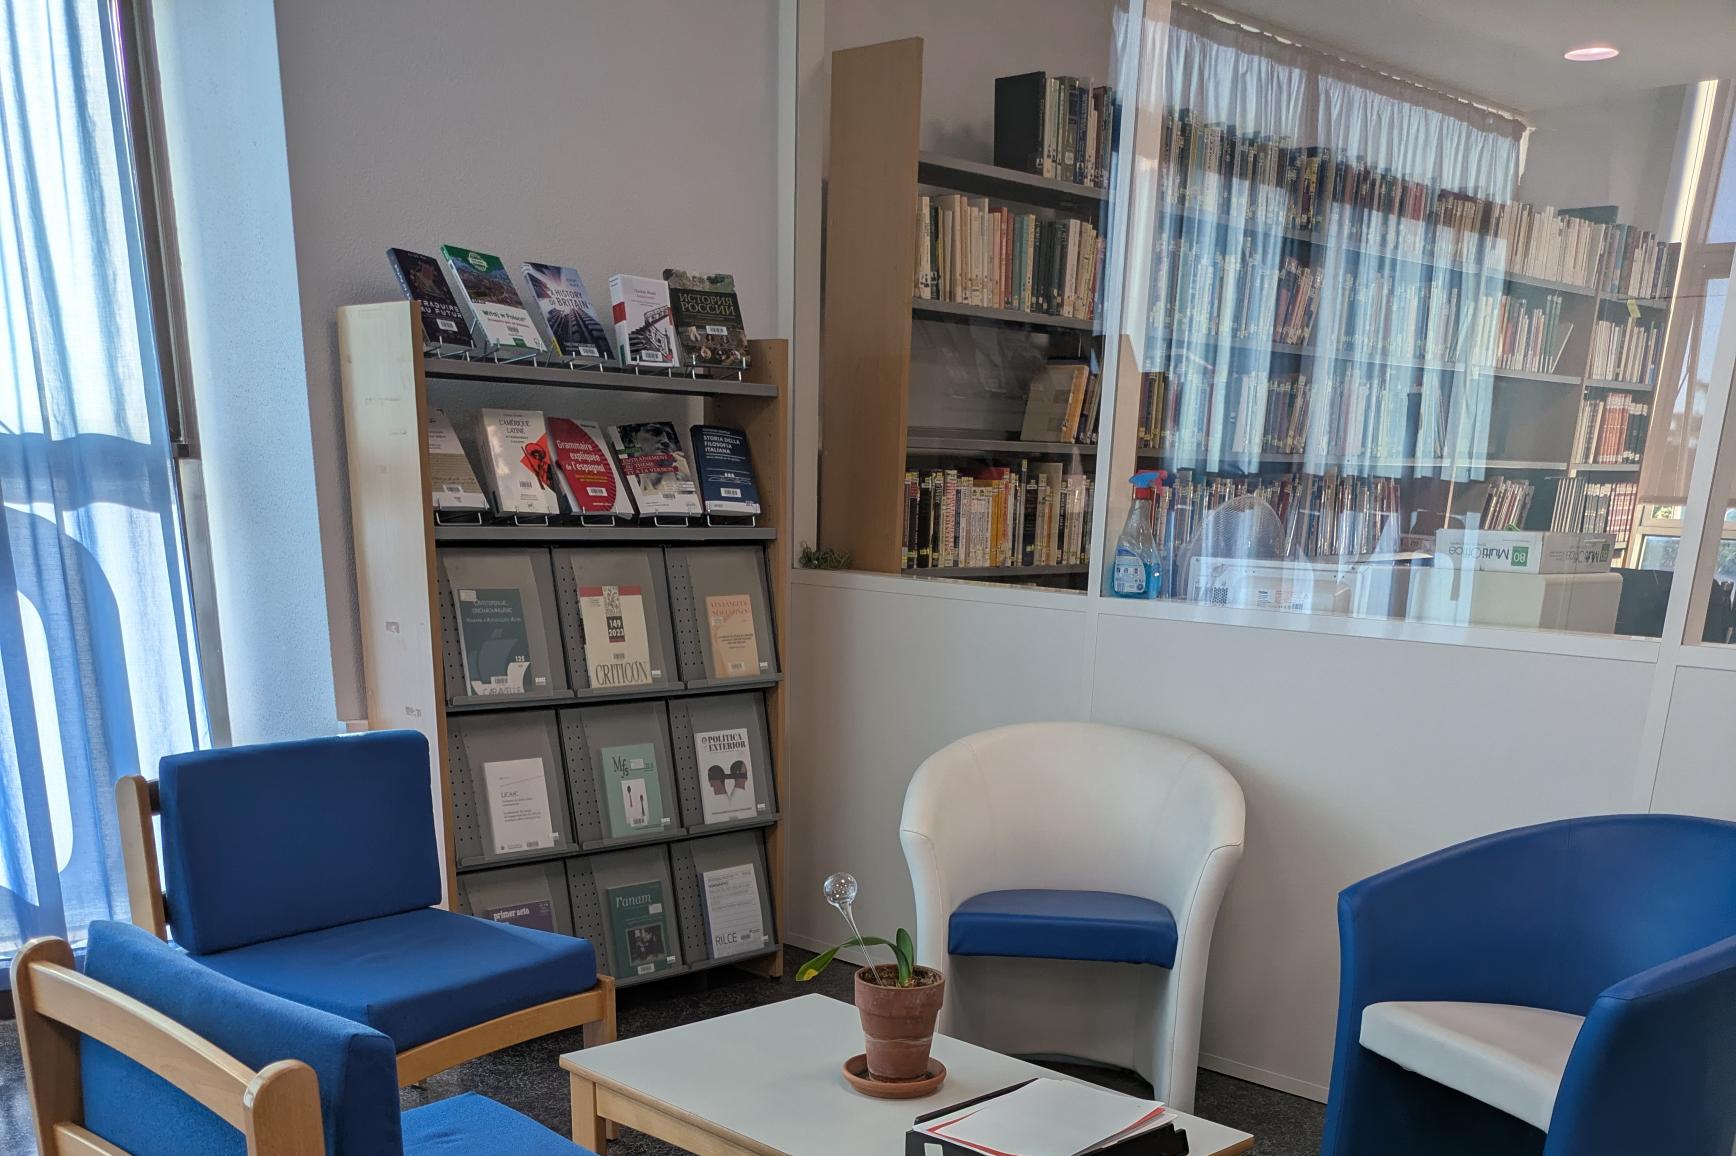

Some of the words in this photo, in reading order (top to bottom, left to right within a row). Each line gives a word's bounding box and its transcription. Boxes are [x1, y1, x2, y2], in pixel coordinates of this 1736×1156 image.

[554, 289, 583, 299] HISTORY
[679, 293, 734, 306] ИСТОРИЯ
[422, 300, 460, 313] RADUIRE
[556, 297, 589, 309] BRITAIN
[681, 302, 736, 315] РОССИИ
[434, 308, 462, 318] FUTUR
[557, 440, 593, 451] Grammaire
[704, 441, 732, 449] FILOSOFIA
[570, 451, 600, 463] expliquée
[572, 461, 606, 473] l'espagnol
[1448, 544, 1510, 561] MultiOffice
[1513, 552, 1526, 562] 80
[609, 619, 621, 628] 149
[595, 660, 649, 686] CRITICÓN
[707, 732, 743, 744] POLÍTICA
[709, 740, 746, 752] EXTERIOR
[616, 893, 651, 909] ranam
[493, 910, 515, 922] primer
[715, 932, 738, 946] RILCE
